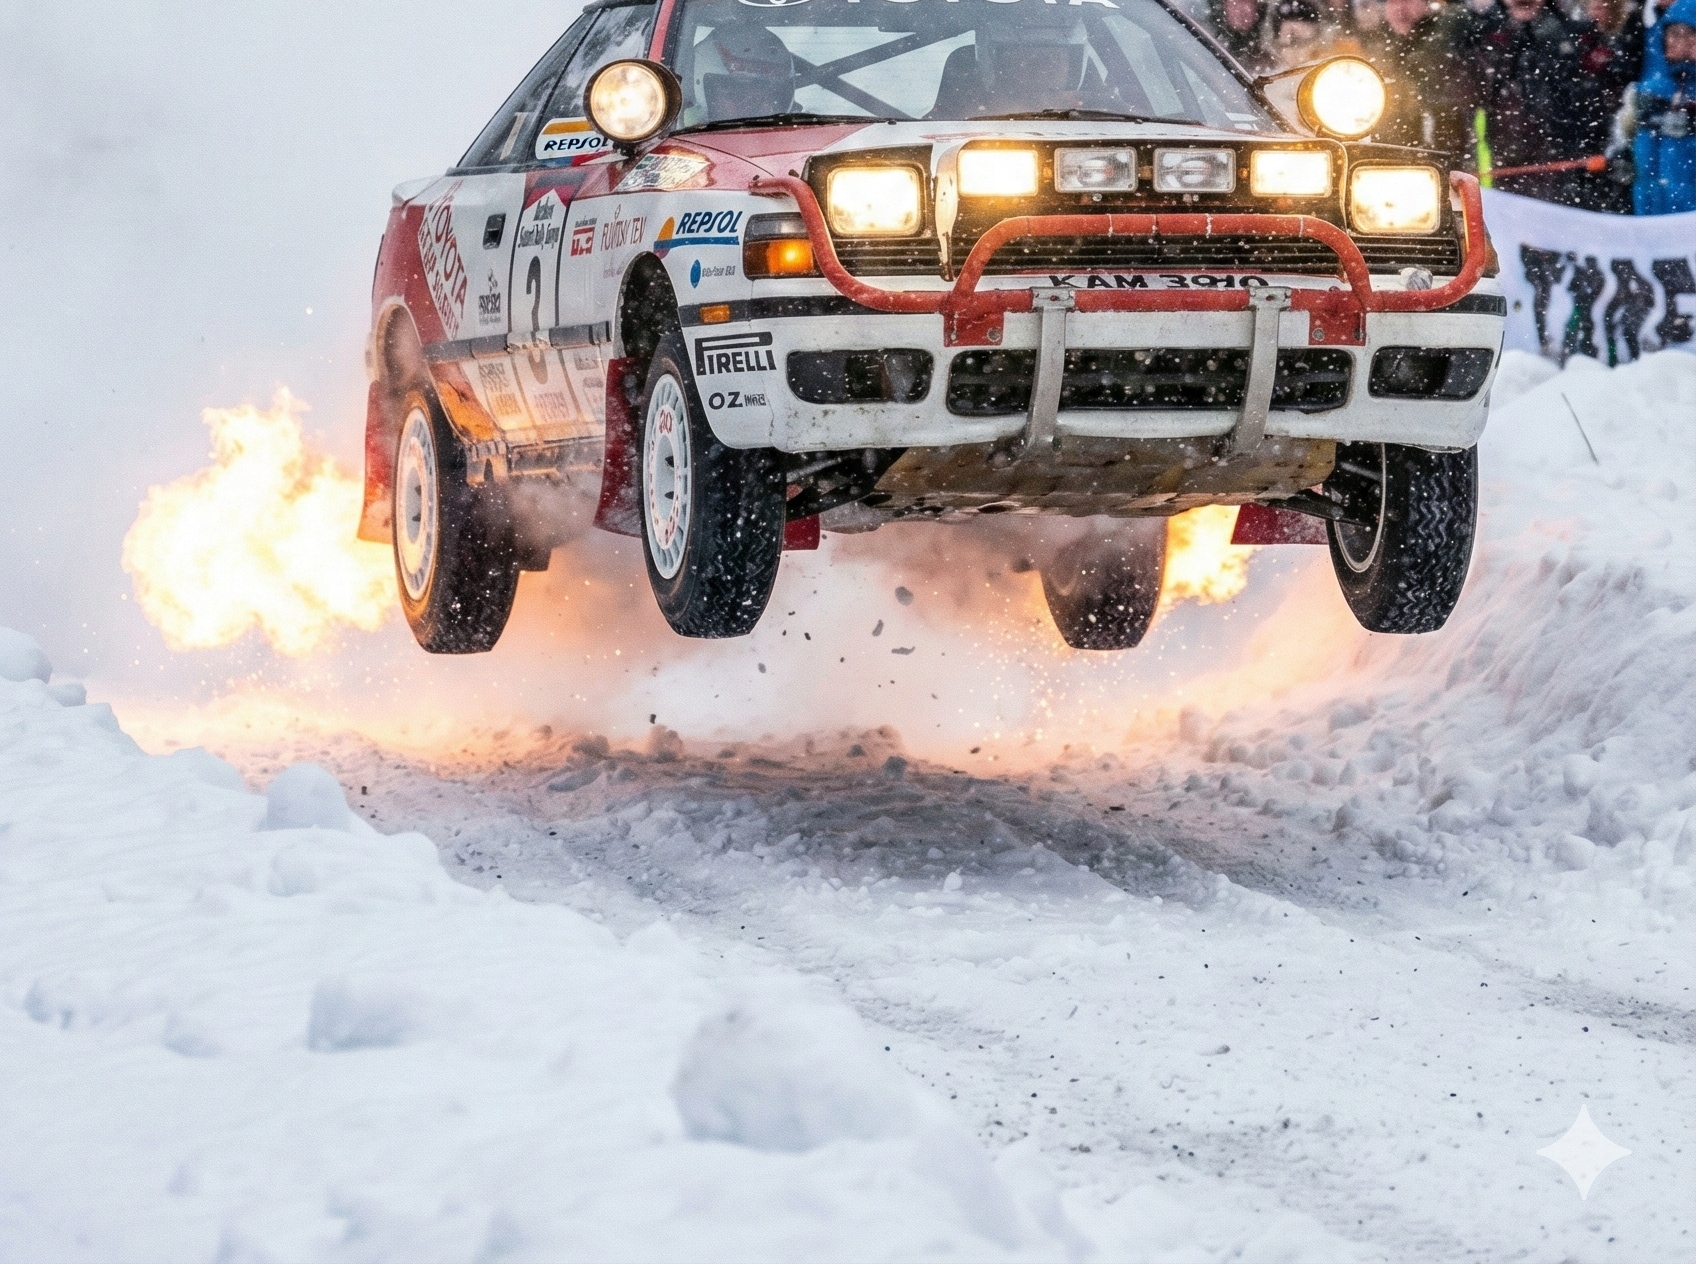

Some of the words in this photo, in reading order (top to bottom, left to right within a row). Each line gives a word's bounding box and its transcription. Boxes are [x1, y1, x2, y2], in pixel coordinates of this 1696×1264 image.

[543, 136, 609, 151] REPSOL
[675, 209, 743, 235] REPSOL
[694, 331, 777, 376] PIRELLI
[708, 391, 743, 410] OZ
